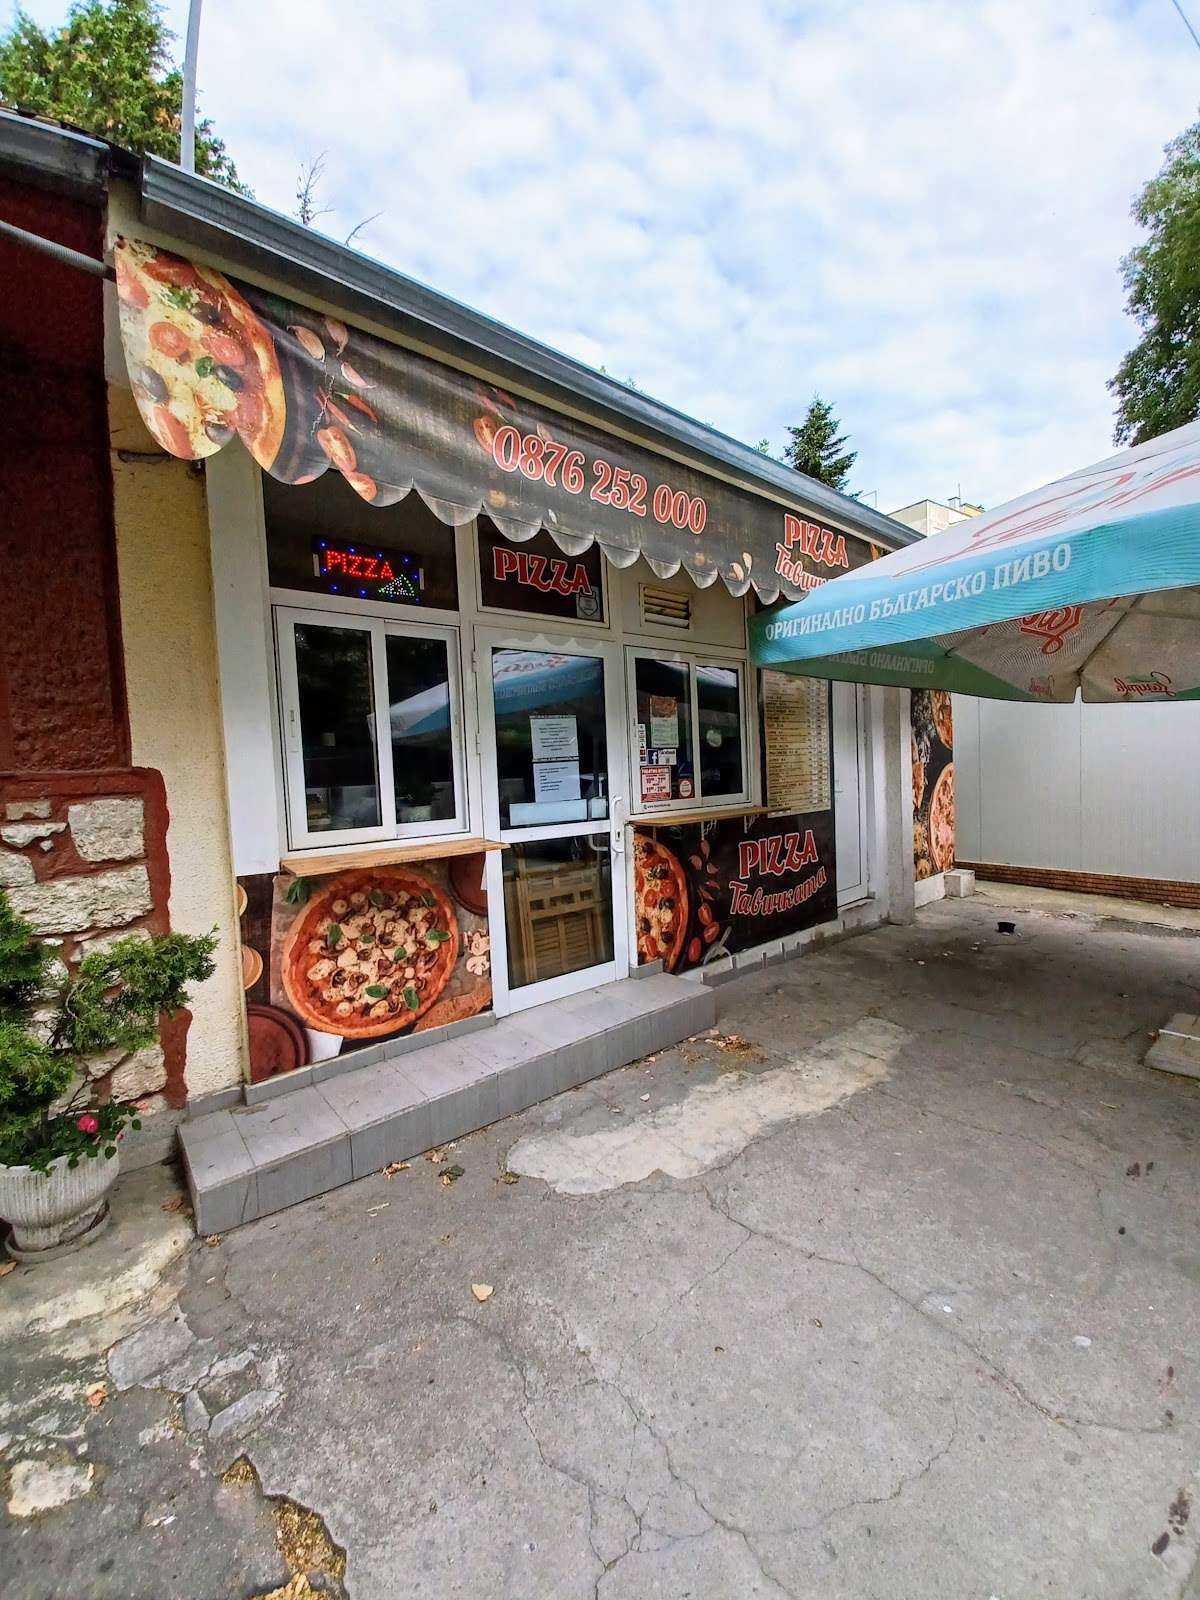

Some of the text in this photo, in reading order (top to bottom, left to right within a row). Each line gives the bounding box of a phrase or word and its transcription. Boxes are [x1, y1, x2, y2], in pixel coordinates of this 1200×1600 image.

[492, 425, 707, 535] 0876 252 000
[326, 550, 395, 580] PIZZA
[784, 513, 849, 568] PIZZA
[492, 546, 593, 596] PIZZA
[765, 543, 1072, 641] ОРИГИНАЛНО БЪЛГАРСКО ПИВО
[738, 830, 819, 880] PIZZA
[729, 866, 827, 916] Тавичката
